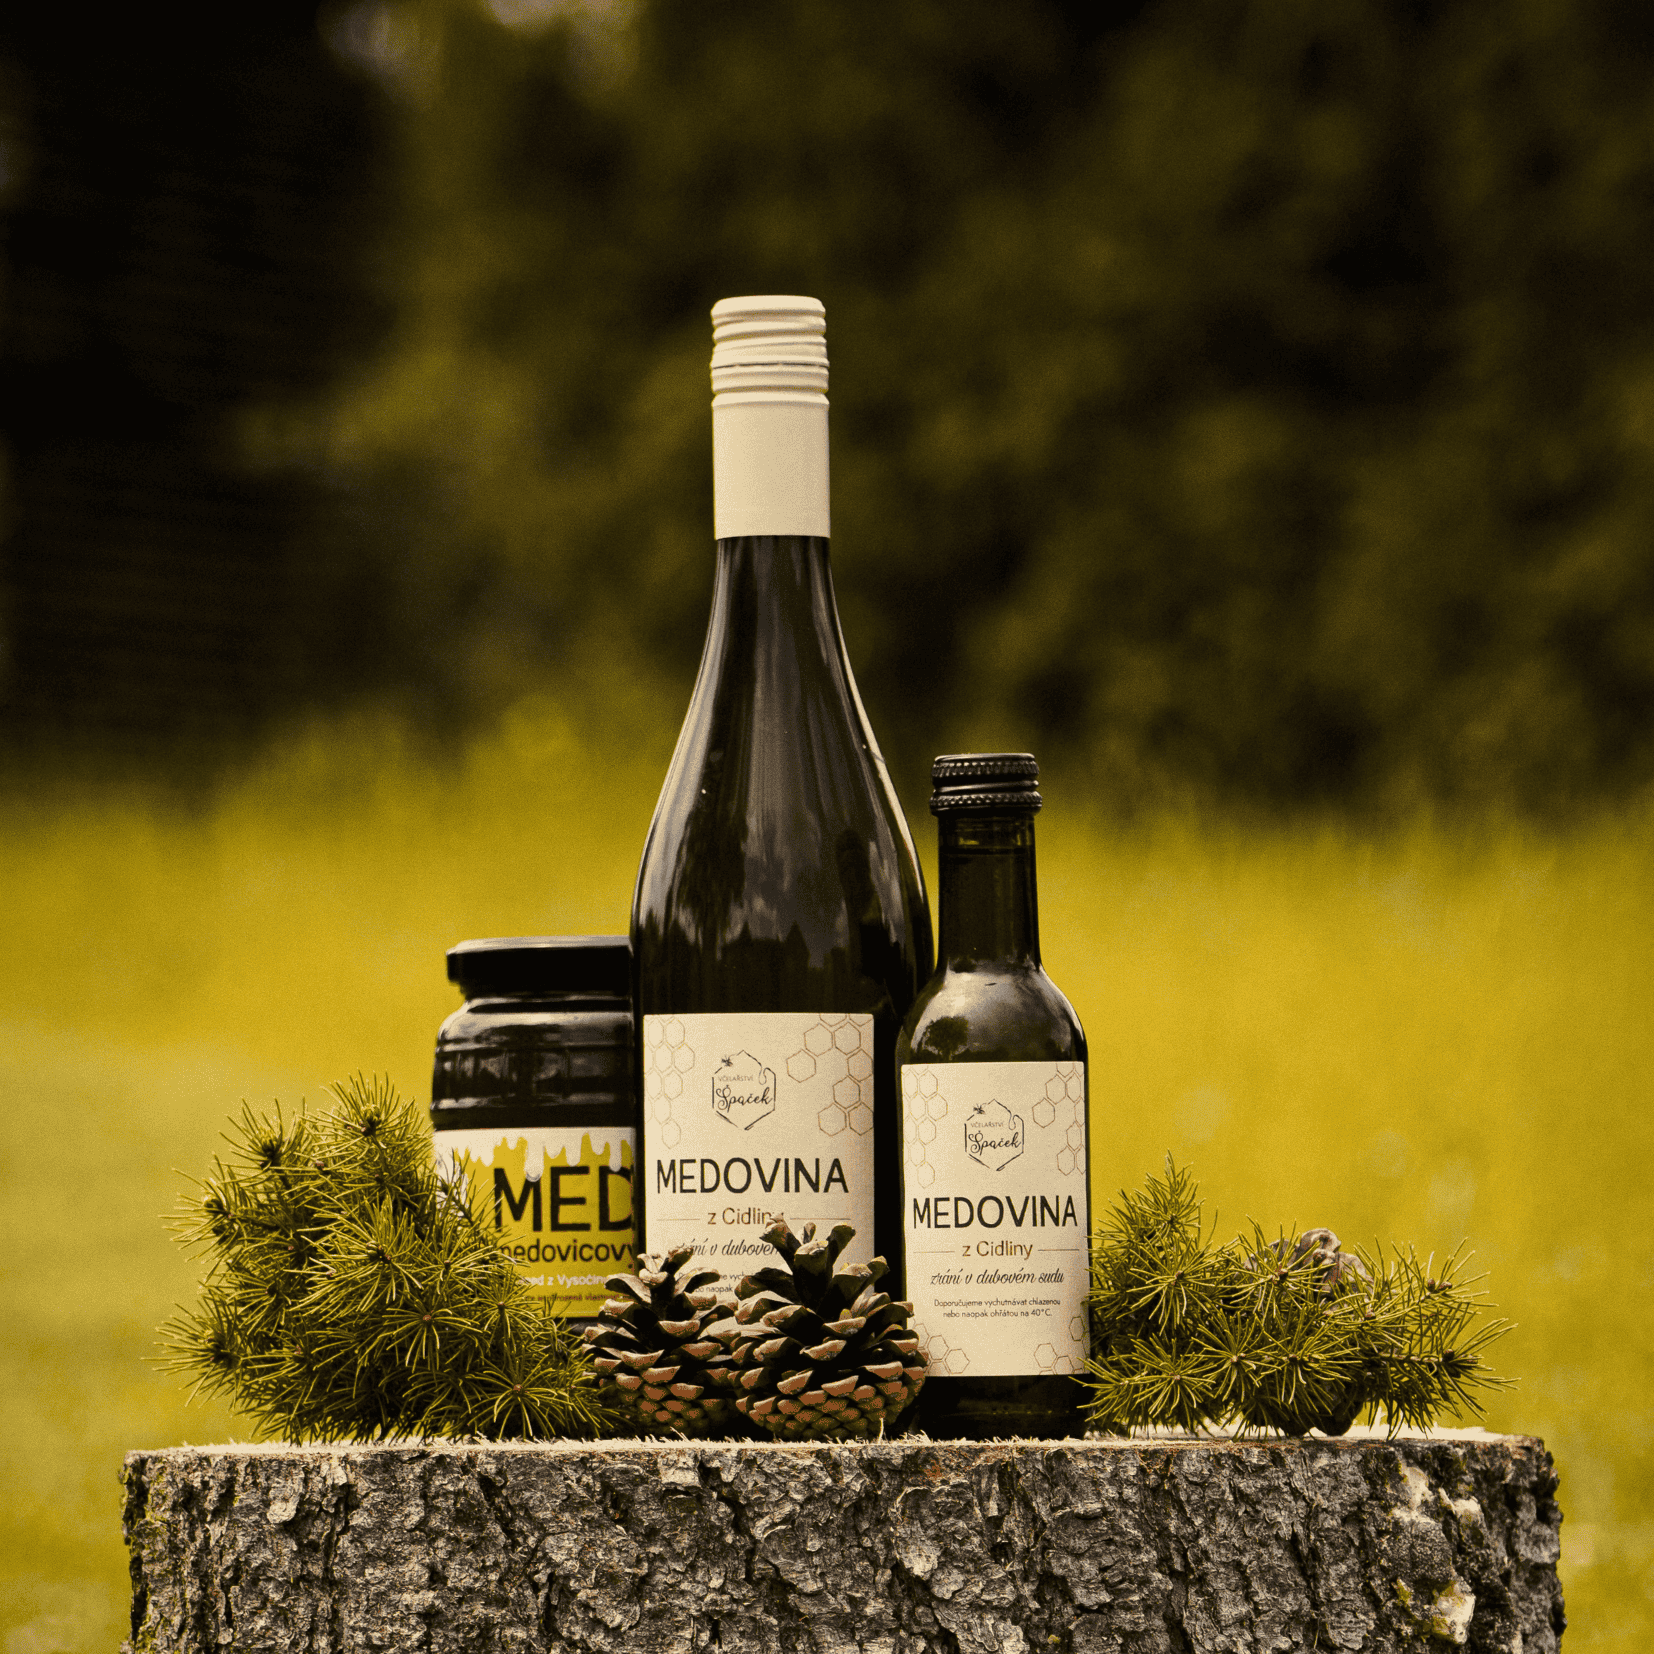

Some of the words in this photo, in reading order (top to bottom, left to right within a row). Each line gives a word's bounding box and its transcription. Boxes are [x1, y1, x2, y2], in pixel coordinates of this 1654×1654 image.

[715, 1084, 774, 1114] Špaček
[968, 1130, 1022, 1156] Špaček
[657, 1157, 849, 1194] MEDOVINA
[493, 1165, 634, 1233] MED
[707, 1212, 717, 1225] z
[722, 1207, 784, 1225] Cidlin
[913, 1195, 1079, 1229] MEDOVINA
[962, 1245, 971, 1257] z
[976, 1240, 1033, 1261] Cidliny
[930, 1268, 963, 1286] zrání
[964, 1273, 973, 1285] v
[976, 1267, 1037, 1285] dubovém
[1038, 1267, 1065, 1284] sudu
[934, 1298, 982, 1308] Doporučujeme
[984, 1297, 1027, 1308] vychutnávat
[1028, 1297, 1061, 1306] chlazenou
[943, 1309, 960, 1318] nebo
[961, 1309, 988, 1319] naopak
[990, 1309, 1018, 1318] ohřátou
